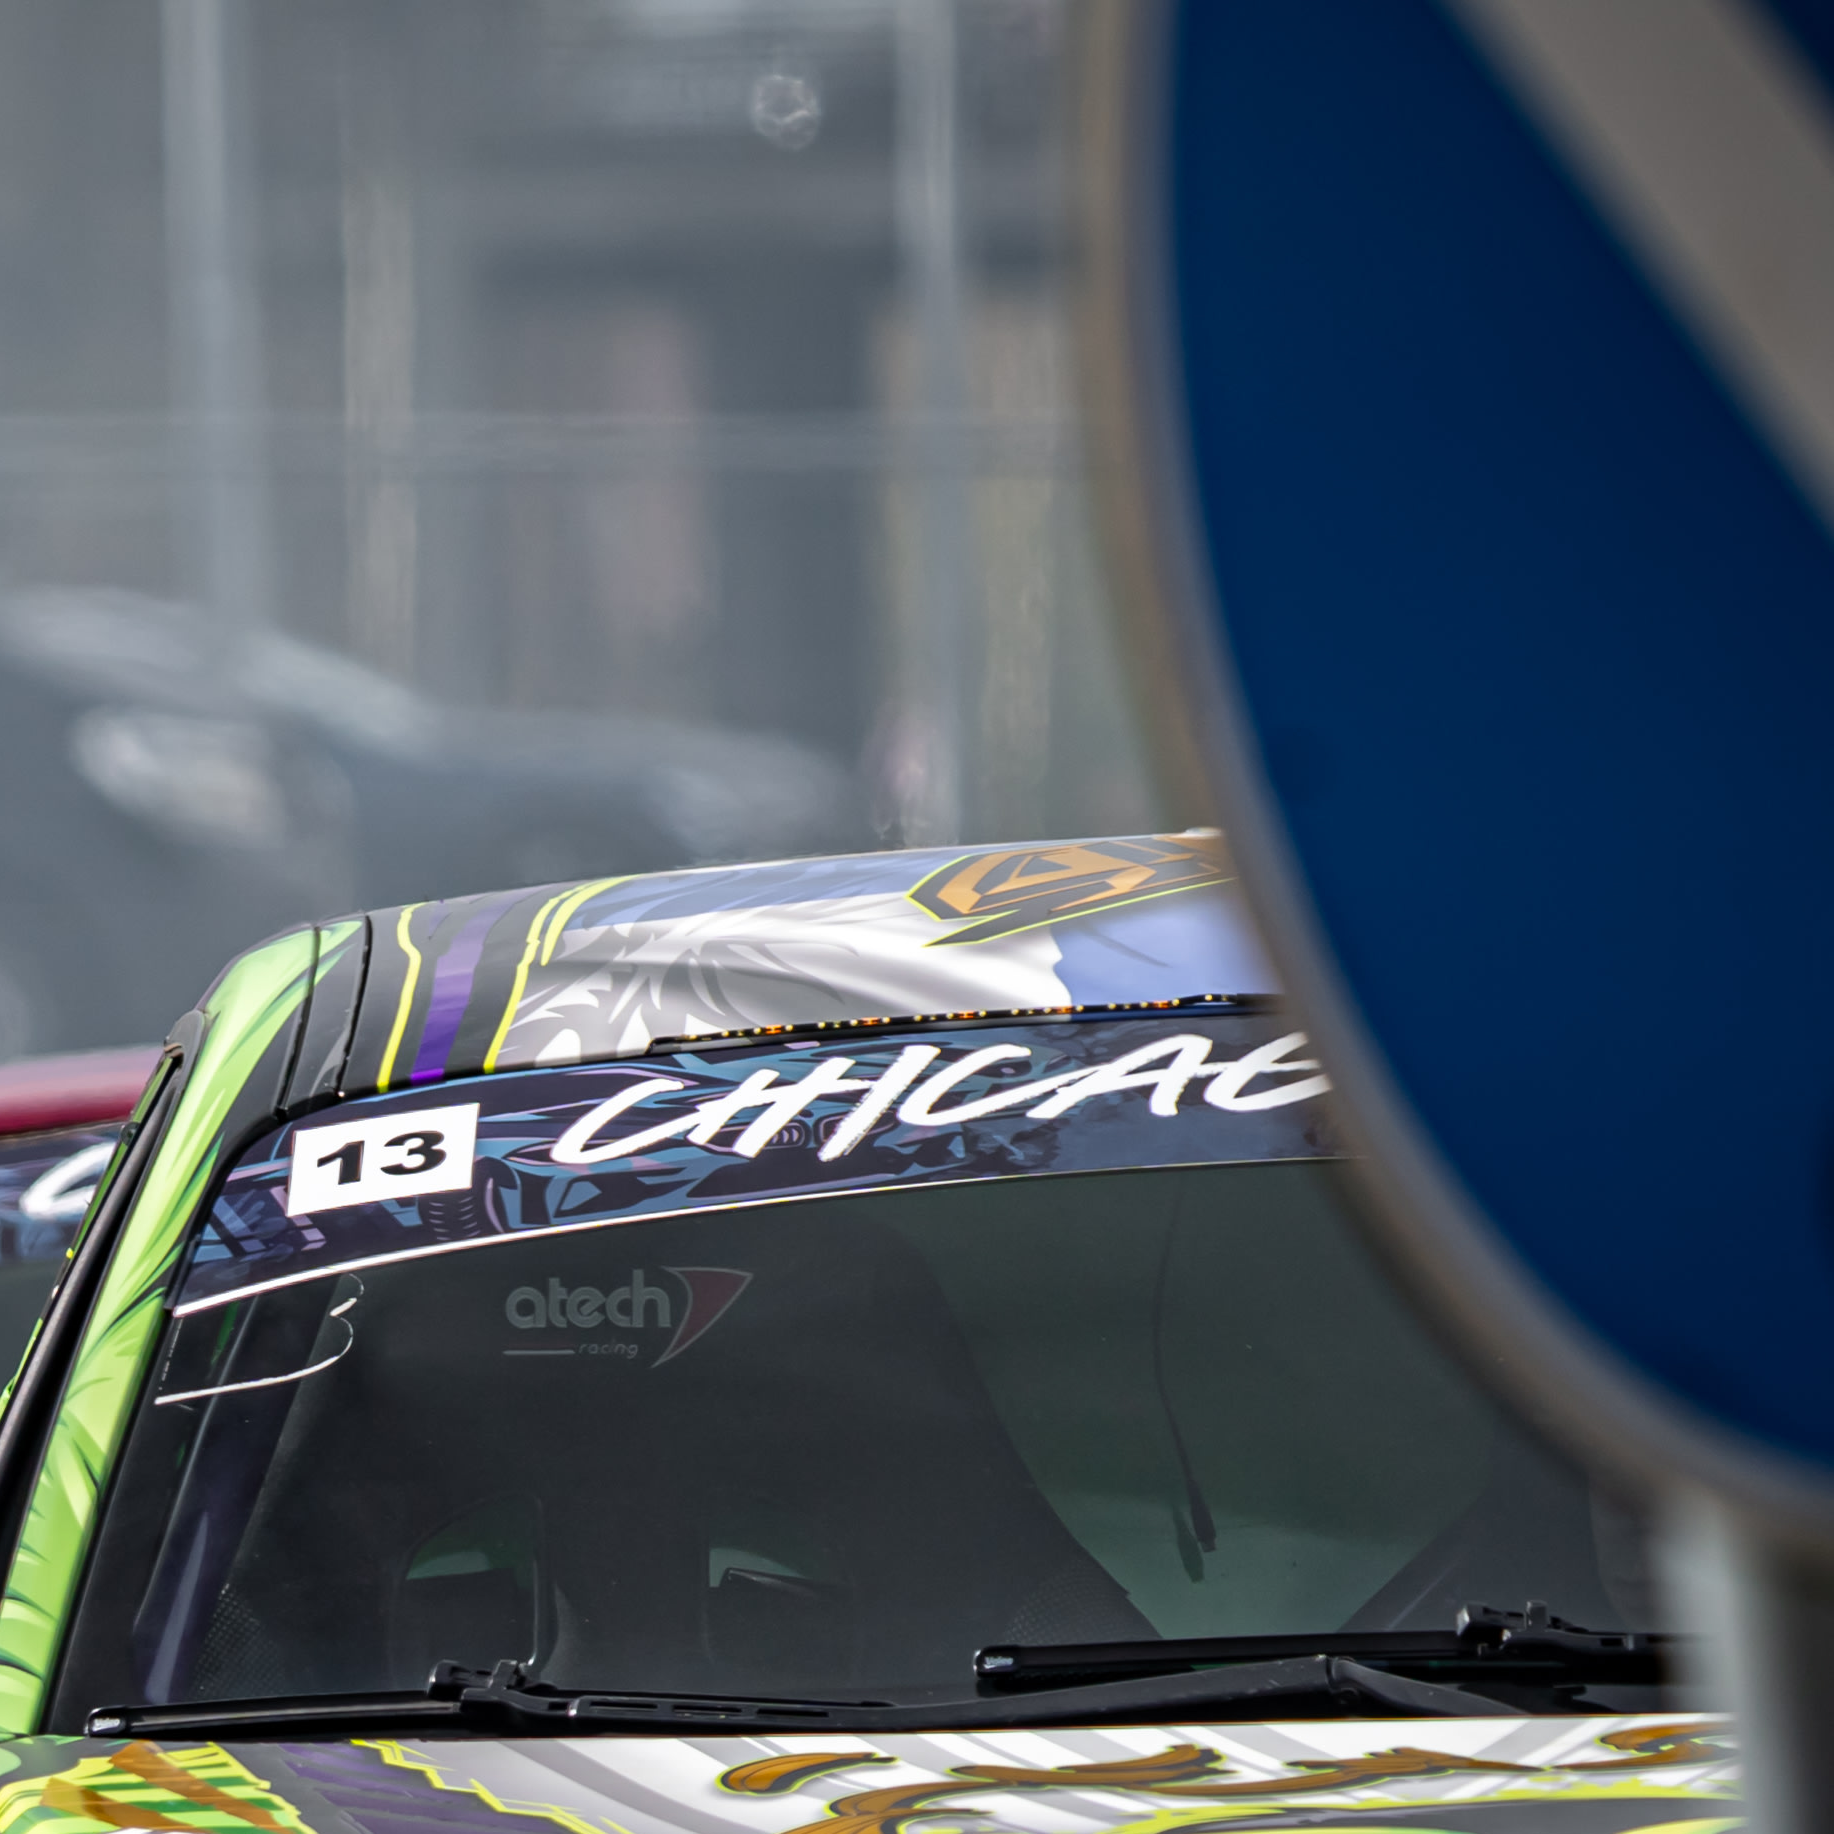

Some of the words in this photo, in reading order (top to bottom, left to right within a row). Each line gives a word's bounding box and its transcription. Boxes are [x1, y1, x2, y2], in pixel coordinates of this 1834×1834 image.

[317, 1131, 448, 1187] 13
[550, 1031, 1334, 1166] CHICAG
[505, 1268, 672, 1329] atech
[578, 1339, 639, 1360] racing
